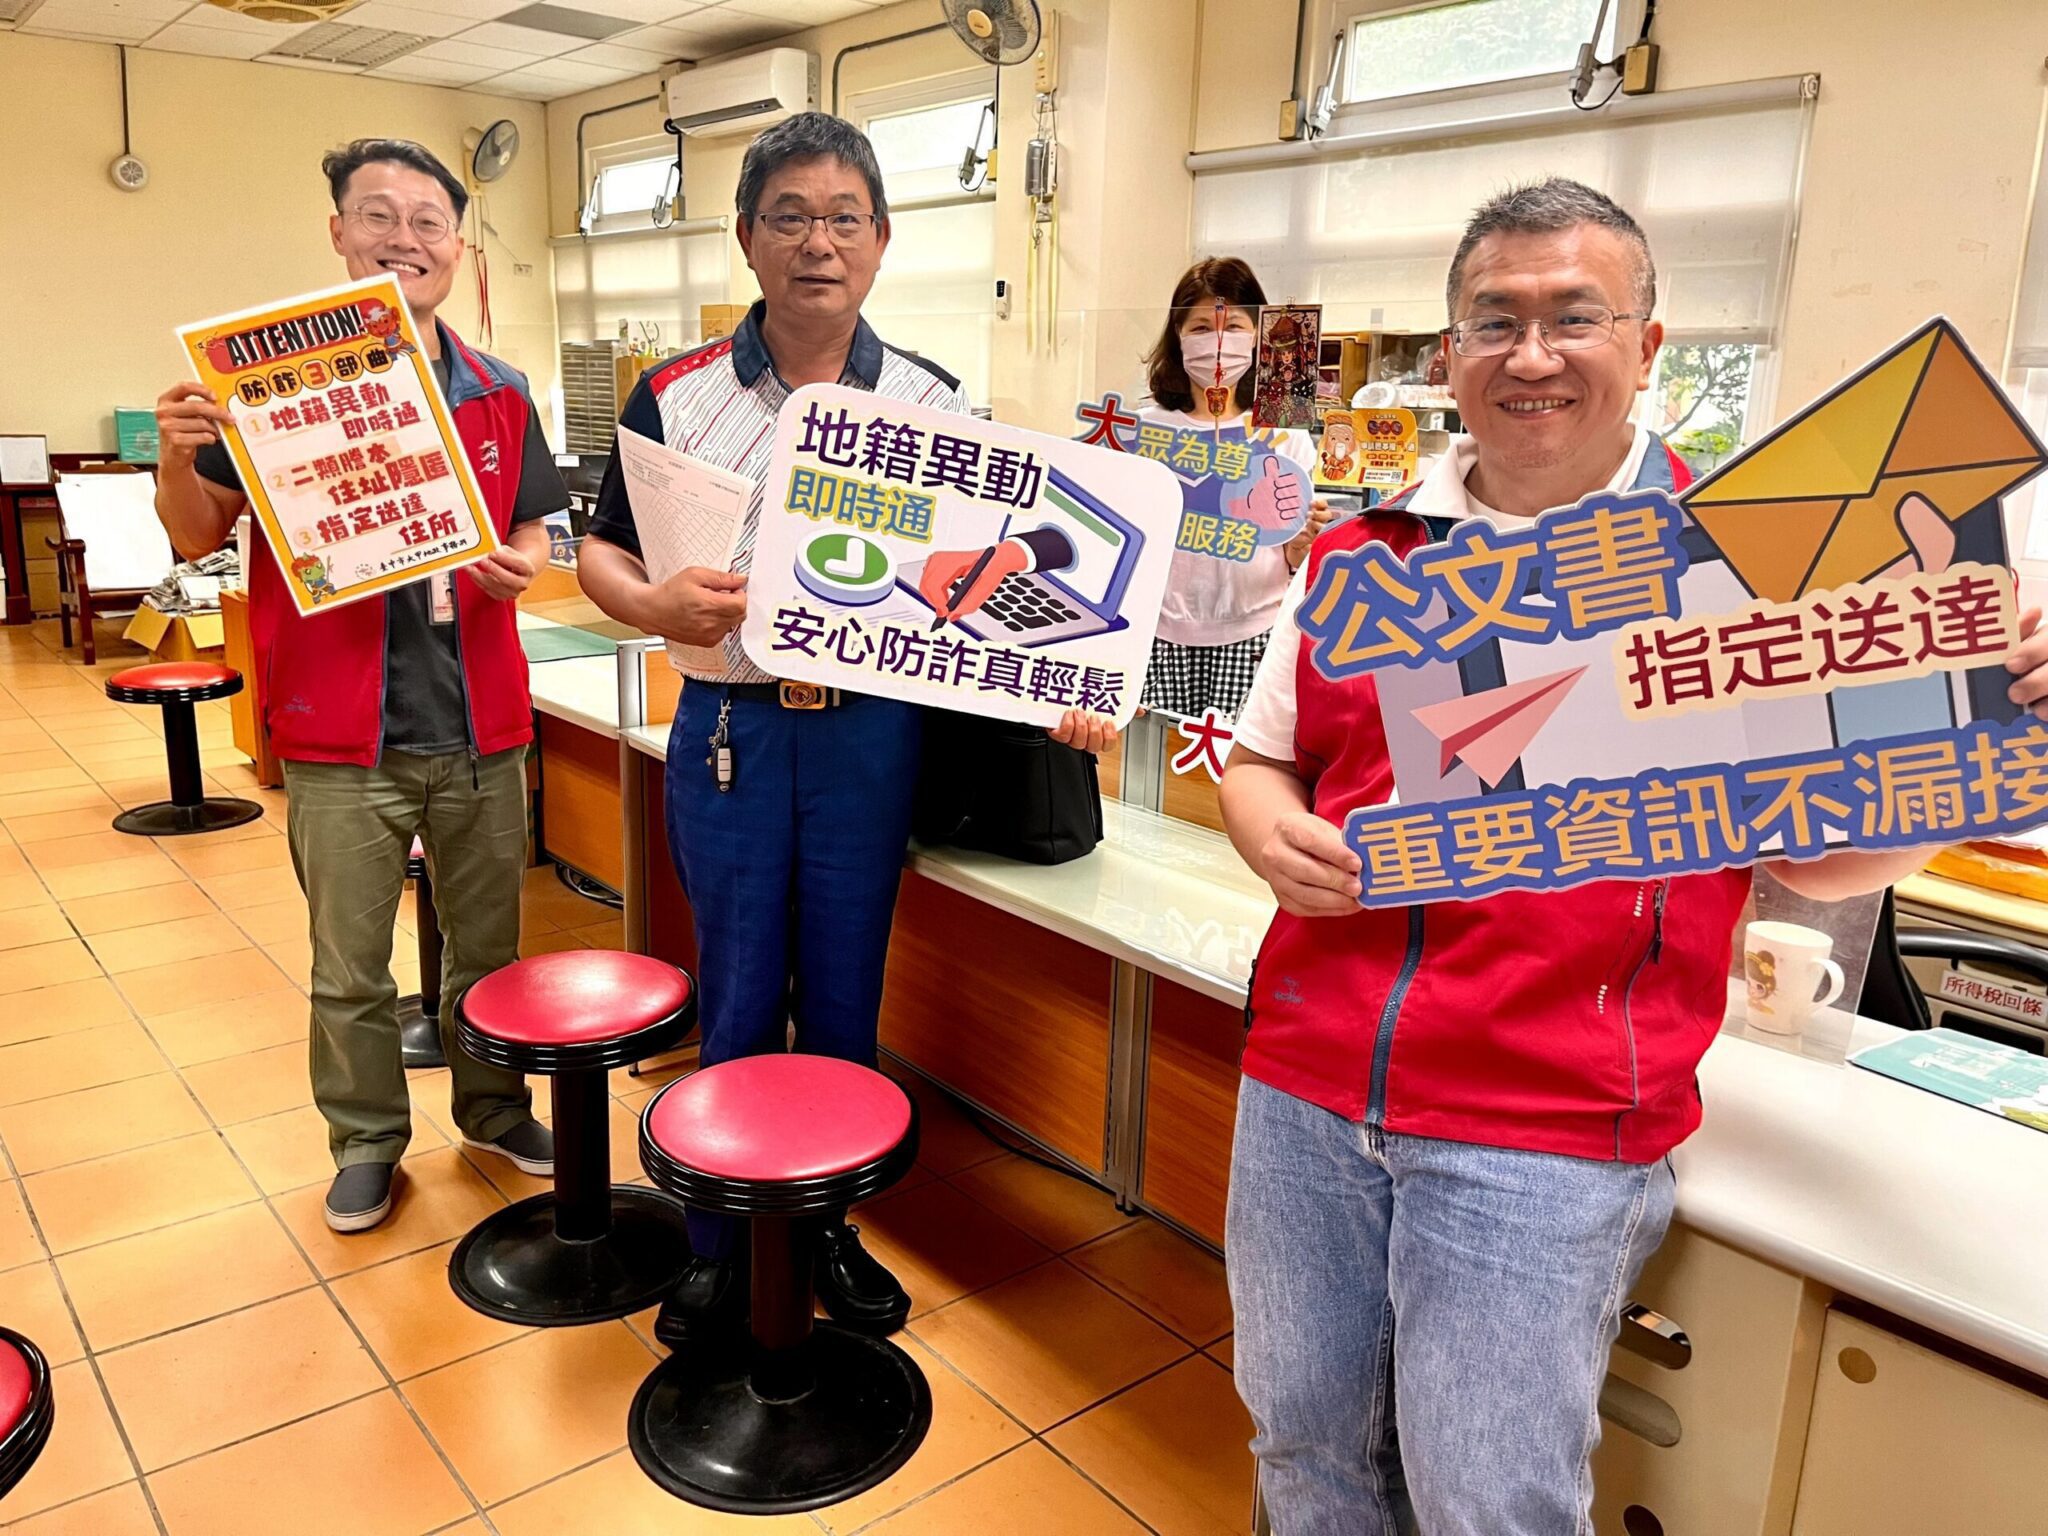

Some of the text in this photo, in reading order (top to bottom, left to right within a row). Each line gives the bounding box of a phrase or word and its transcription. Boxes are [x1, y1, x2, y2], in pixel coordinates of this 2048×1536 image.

[225, 304, 369, 367] ATTENTION!
[240, 348, 390, 403] 防詐3部曲
[269, 382, 391, 432] 地籍異動
[341, 401, 421, 440] 即時通
[1082, 399, 1252, 480] 大眾為尊
[290, 443, 391, 487] 二類謄本
[327, 450, 449, 506] 住址隱匿
[796, 402, 1042, 509] 地籍異動
[317, 493, 427, 543] 指定送達
[398, 510, 458, 546] 住所
[789, 468, 935, 541] 即時通
[1178, 512, 1258, 560] 服務
[1311, 507, 1674, 667] 公文書
[771, 607, 1126, 717] 安心防詐真輕鬆
[1627, 576, 2008, 709] 指定送達
[1176, 713, 1233, 778] 大
[1360, 725, 2048, 895] 重要資訊不漏接
